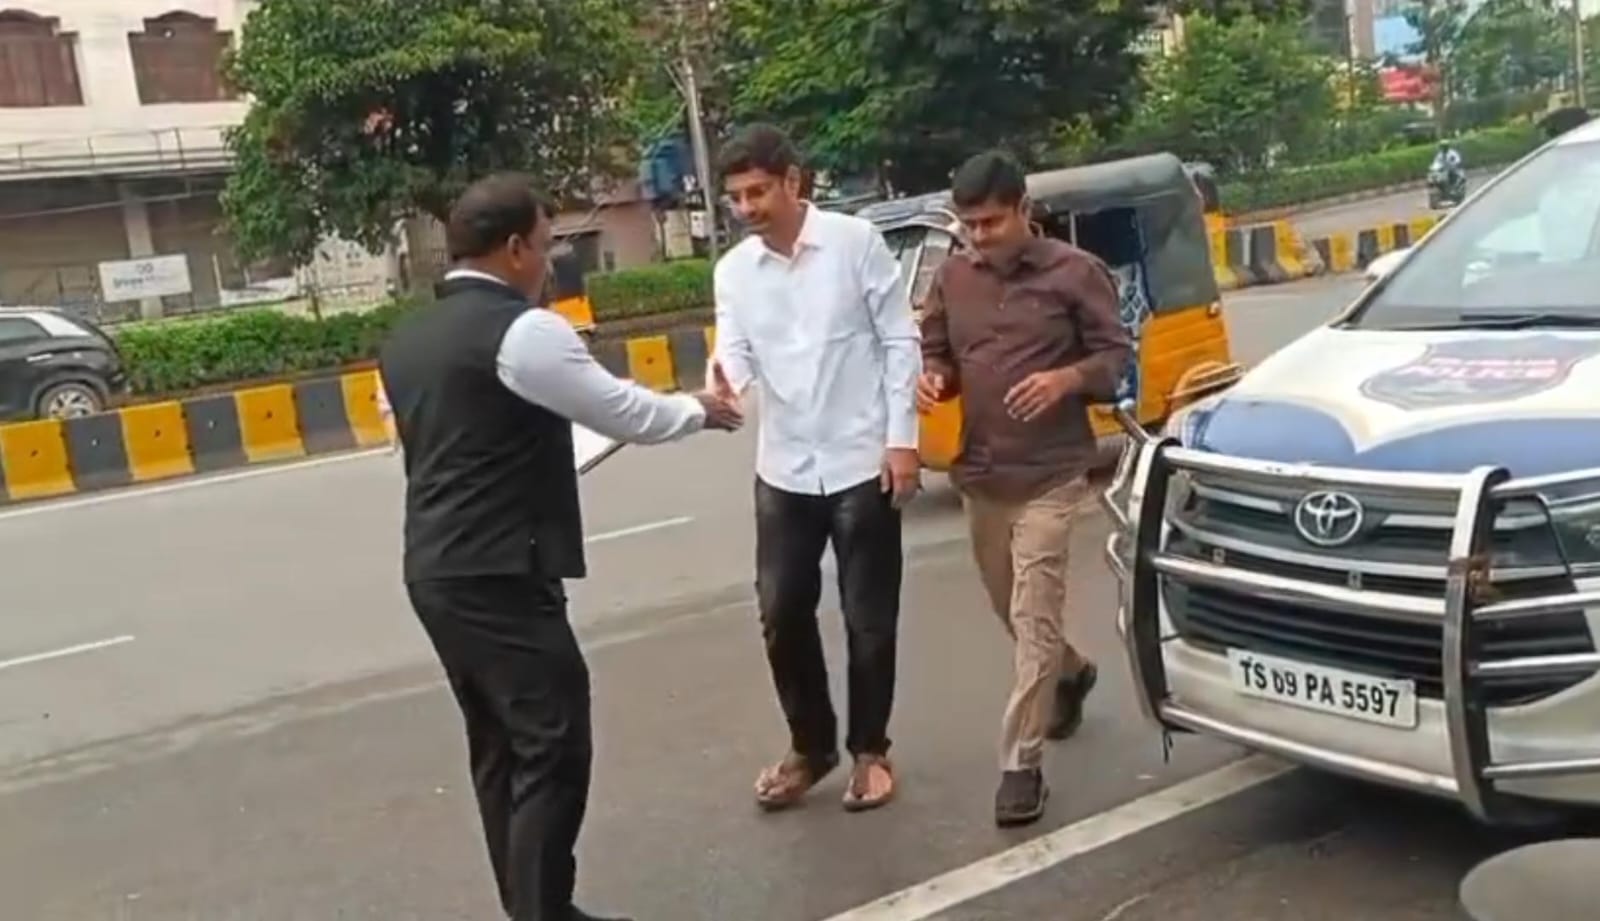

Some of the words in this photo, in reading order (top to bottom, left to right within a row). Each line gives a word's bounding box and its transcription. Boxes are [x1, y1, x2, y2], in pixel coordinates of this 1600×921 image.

[1239, 659, 1268, 690] TS
[1305, 673, 1336, 706] PA
[1342, 680, 1400, 718] 5597
